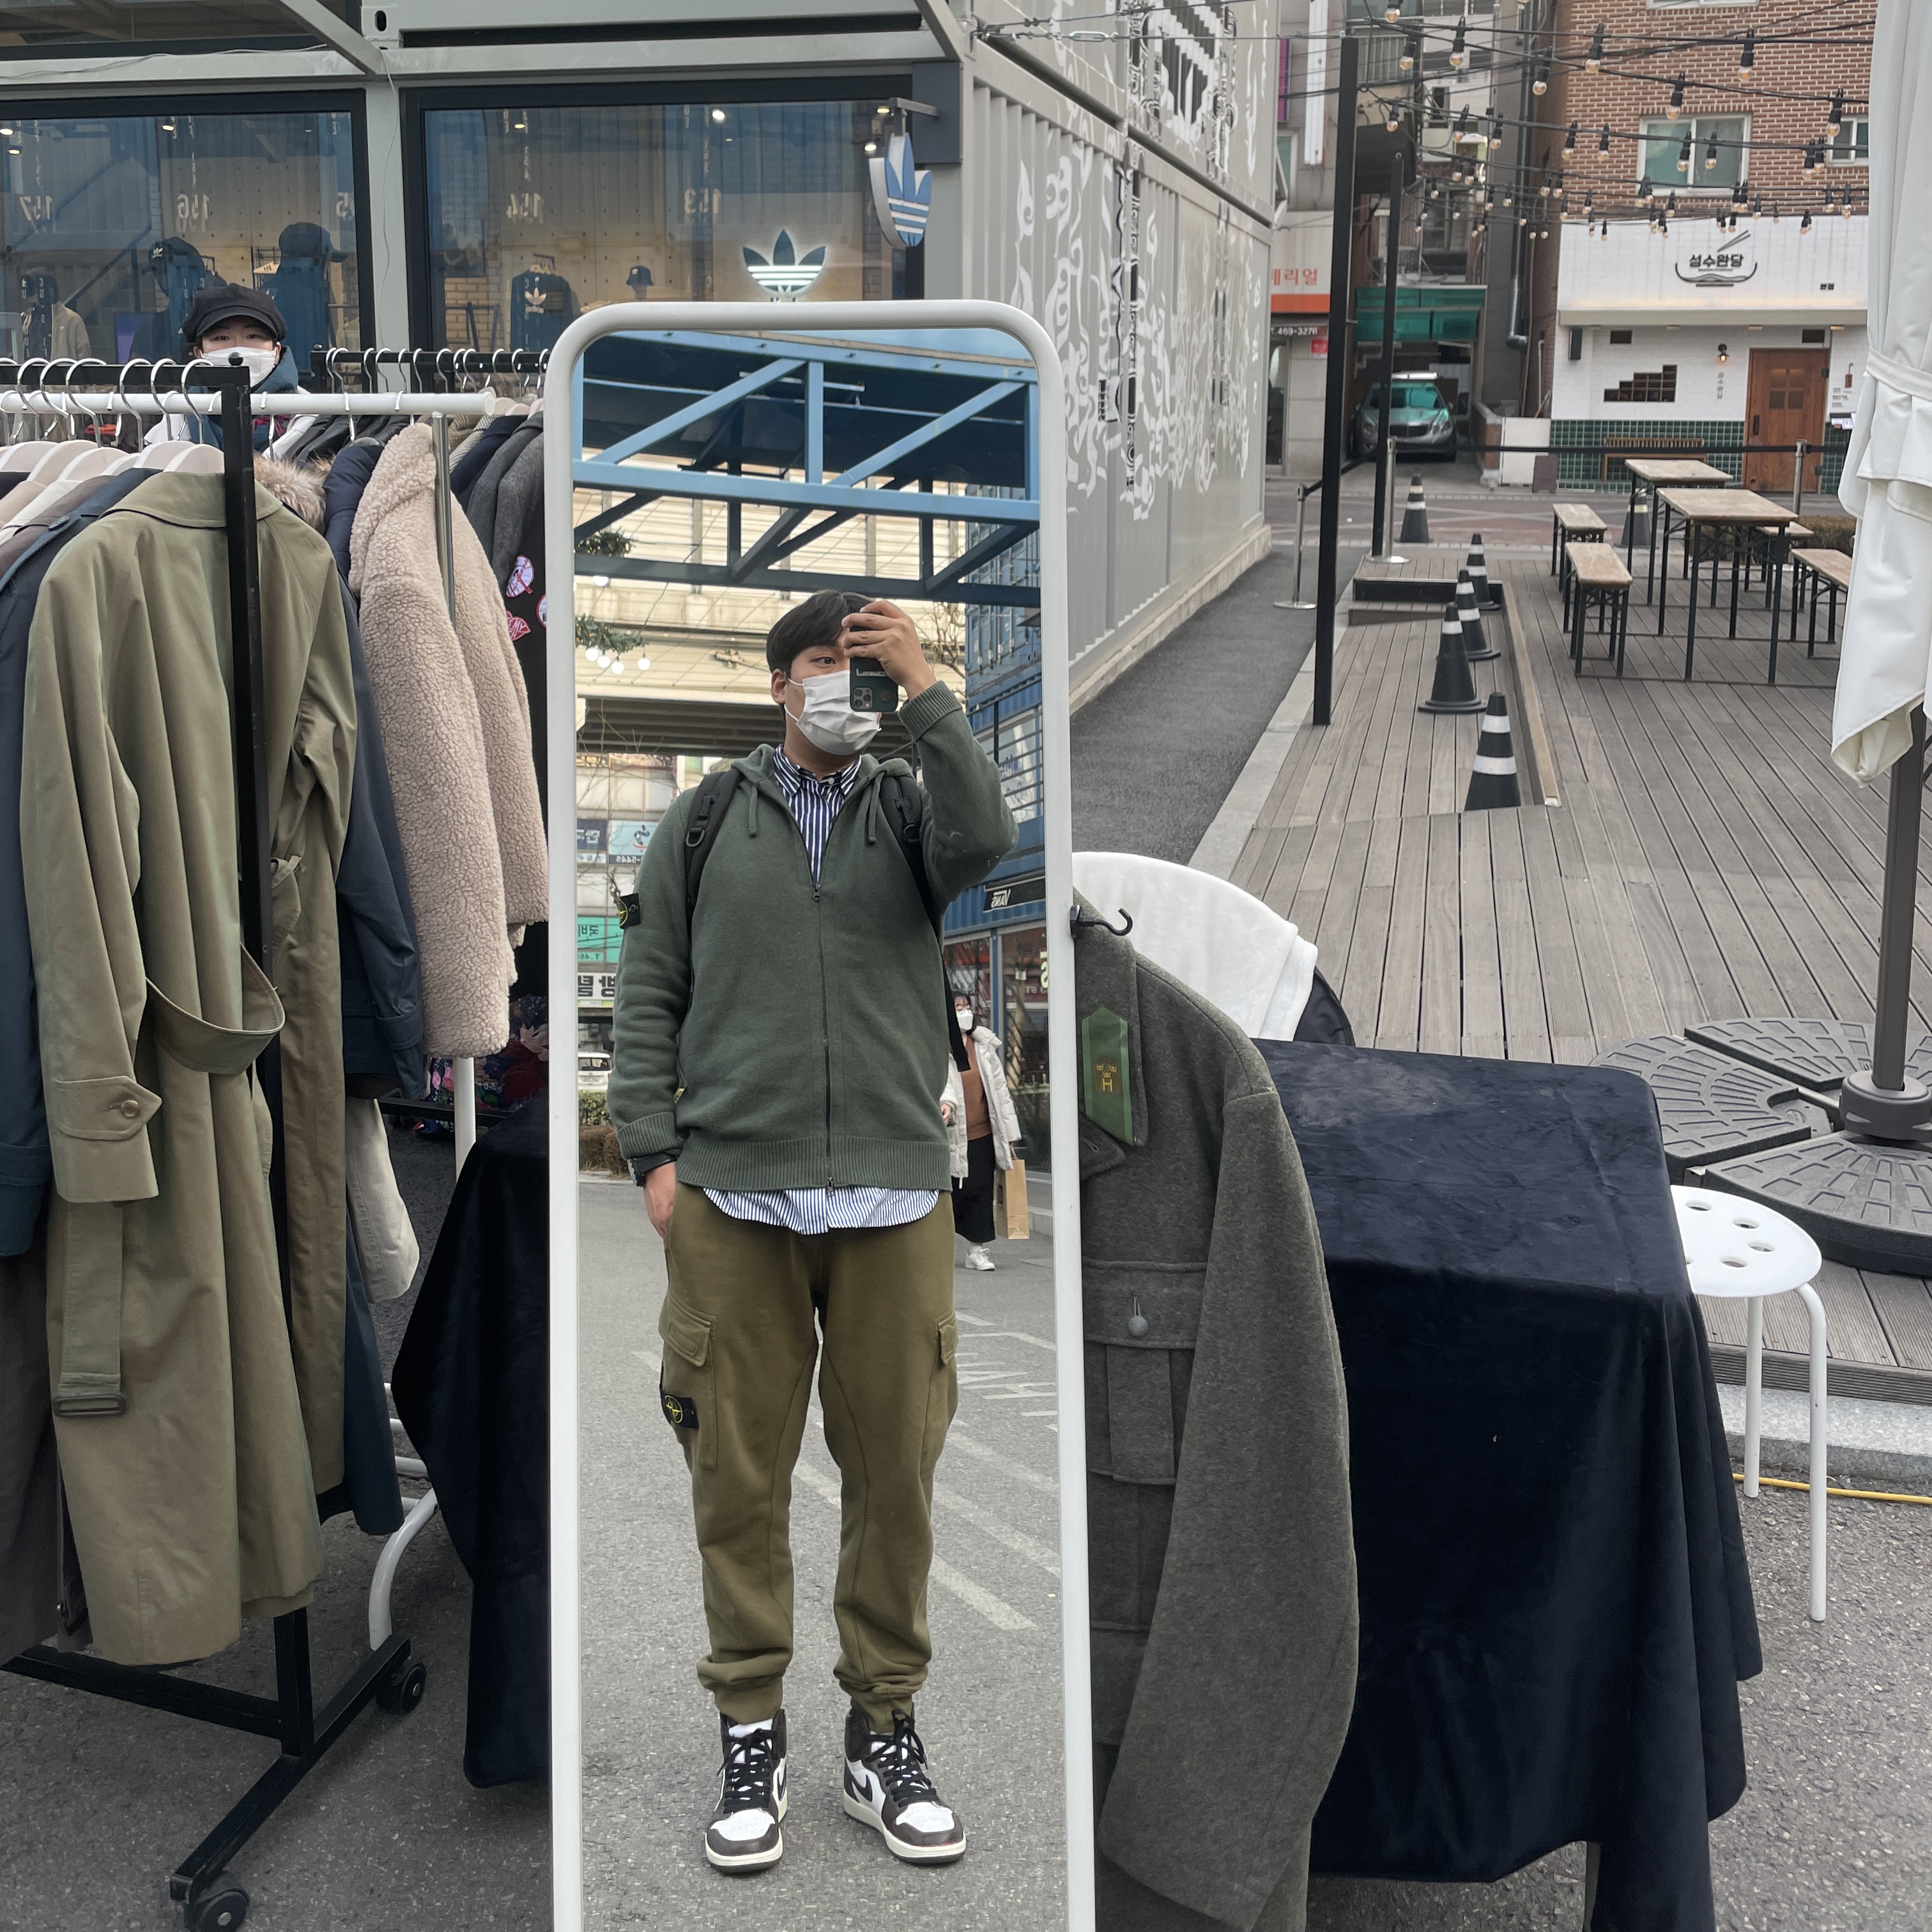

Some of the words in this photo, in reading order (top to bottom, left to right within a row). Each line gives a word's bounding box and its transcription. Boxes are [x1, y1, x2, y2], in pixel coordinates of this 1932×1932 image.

[1689, 254, 1744, 268] 성수완당
[1271, 268, 1318, 286] 리얼
[1101, 1078, 1114, 1092] H
